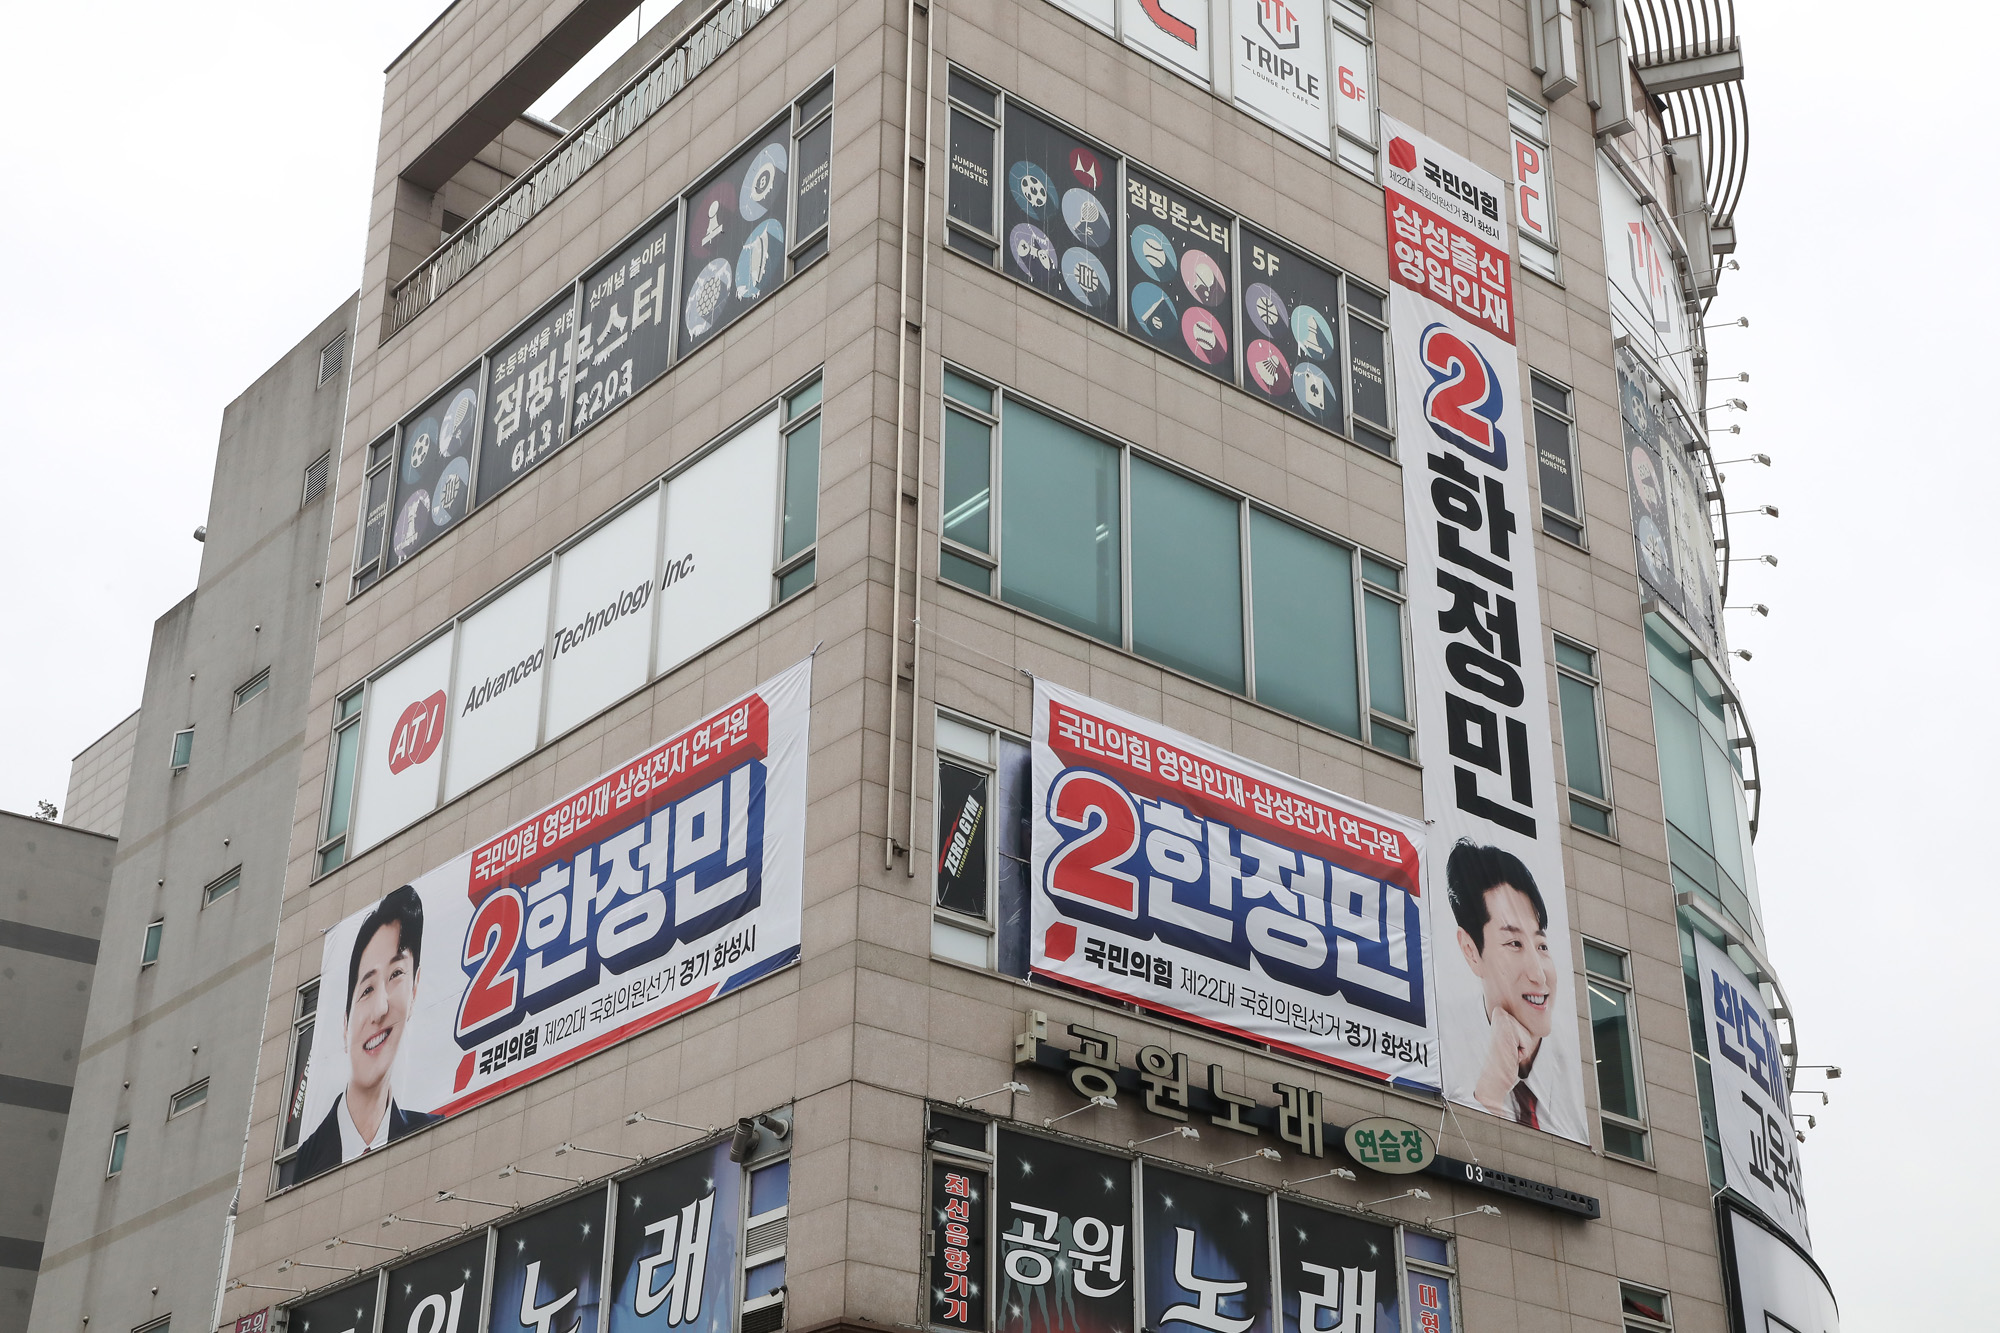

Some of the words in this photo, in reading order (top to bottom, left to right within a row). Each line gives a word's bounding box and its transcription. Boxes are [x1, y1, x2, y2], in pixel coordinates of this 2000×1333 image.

[1241, 35, 1320, 101] TRIPLE
[1252, 69, 1279, 89] LOUNGE
[1281, 85, 1290, 95] PC
[1292, 91, 1309, 106] CAFE
[1338, 66, 1366, 102] 6F
[800, 170, 829, 196] MONSTER
[801, 160, 829, 186] JUMPING
[951, 162, 989, 187] MONSTER
[952, 154, 988, 177] JUMPING
[1423, 157, 1499, 222] 국민의힘
[1128, 178, 1230, 254] 점핑몬스터
[1389, 169, 1416, 192] 제22대
[1417, 183, 1461, 218] 국회의원선거
[1461, 209, 1477, 228] 경기
[1477, 217, 1500, 241] 화성시
[1252, 245, 1280, 277] 5F
[1392, 202, 1505, 295] 삼성출신
[494, 326, 550, 384] 초등학생을
[589, 265, 626, 312] 신개념
[629, 232, 667, 280] 놀이터
[1394, 241, 1510, 334] 영입인재
[494, 263, 666, 448] 점핑몬스터
[1353, 356, 1381, 376] JUMPING
[1353, 365, 1382, 385] MONSTER
[1421, 324, 1499, 458] 2
[1540, 448, 1566, 467] JUMPING
[1540, 456, 1567, 475] MONSTER
[461, 642, 546, 718] Advanced
[552, 579, 654, 660] Technology
[661, 552, 696, 592] Inc.
[1426, 450, 1538, 841] 한정민
[474, 823, 539, 881] 국민의힘
[692, 703, 750, 768] 연구원
[1058, 708, 1152, 774] 국민의힘
[1340, 821, 1403, 864] 연구원
[944, 831, 967, 877] ZERO
[958, 794, 980, 835] GYM
[523, 760, 752, 999] 한정민
[1143, 795, 1412, 1003] 한정민
[478, 1025, 539, 1076] 국민의힘
[542, 1005, 587, 1048] 제22대
[589, 965, 676, 1024] 국회의원선거
[679, 952, 712, 987] 경기
[713, 925, 757, 974] 화성시
[1084, 937, 1174, 990] 국민의힘
[1180, 970, 1236, 1008] 제22대
[1239, 986, 1343, 1041] 국회의원선거
[1343, 1018, 1377, 1053] 경기
[1381, 1030, 1429, 1069] 화성시
[291, 1079, 307, 1119] ZERO
[1353, 1128, 1424, 1166] 연습장
[943, 1172, 971, 1323] 최신음향기기
